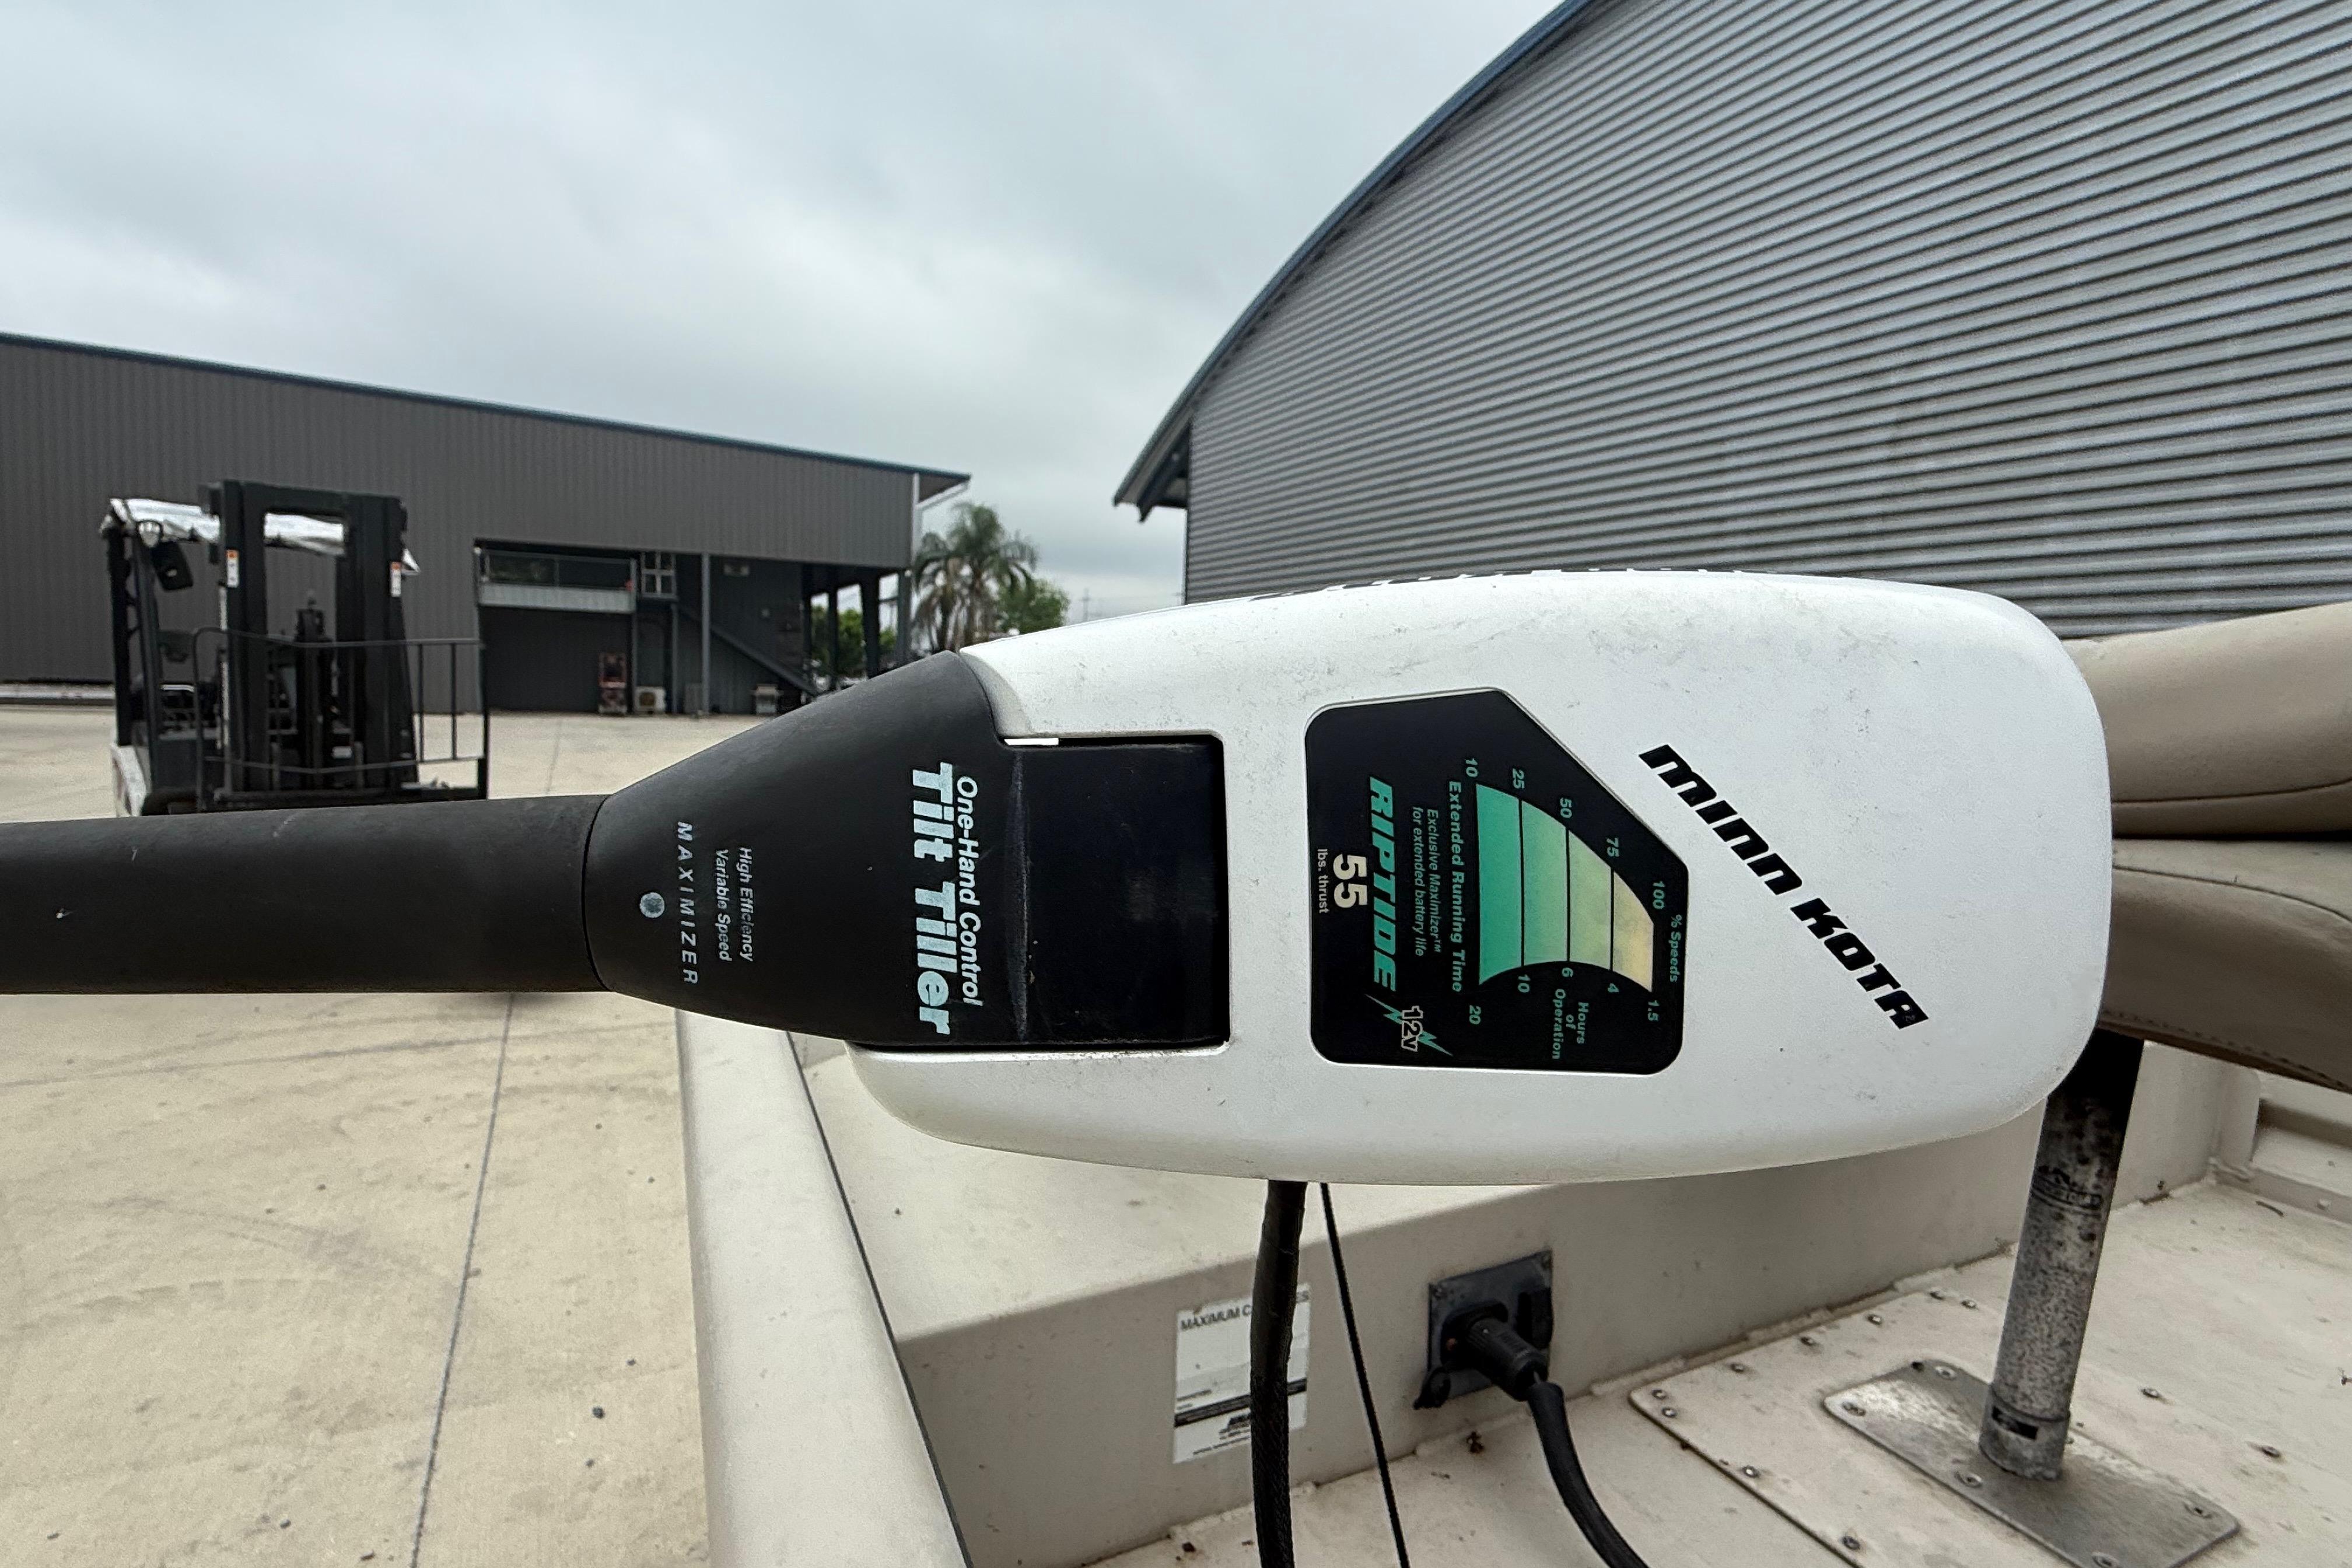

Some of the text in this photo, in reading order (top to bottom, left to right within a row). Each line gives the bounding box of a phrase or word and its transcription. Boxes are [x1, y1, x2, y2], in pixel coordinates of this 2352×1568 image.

[1465, 758, 1478, 778] 10
[1512, 768, 1525, 789] 25
[1560, 797, 1573, 819] 50
[1427, 808, 1440, 871] Exclusive
[1606, 837, 1619, 858] 75
[677, 821, 698, 984] MAXIMIZER
[715, 849, 733, 962] Variable Speed
[735, 847, 755, 962] High Efficiency
[912, 761, 958, 1035] Tilt Tiller
[956, 776, 983, 1006] One-Hand Control
[1317, 848, 1329, 914] lbs. thrust
[1333, 853, 1367, 908] 55
[1370, 776, 1396, 992] RIPTIDE
[1412, 806, 1427, 957] for extended battery life
[1449, 780, 1466, 992] Extended Running Time
[1652, 880, 1665, 910] 100
[1517, 974, 1531, 993] 10
[1561, 967, 1574, 978] 6
[1668, 931, 1682, 983] Speeds
[1790, 897, 1929, 1029] KOTA
[1607, 982, 1619, 993] 4
[1647, 999, 1660, 1021] 1.5
[1468, 1005, 1482, 1025] 20
[1552, 988, 1566, 1060] Operation
[1565, 1014, 1576, 1030] of
[1576, 1001, 1590, 1044] Hours
